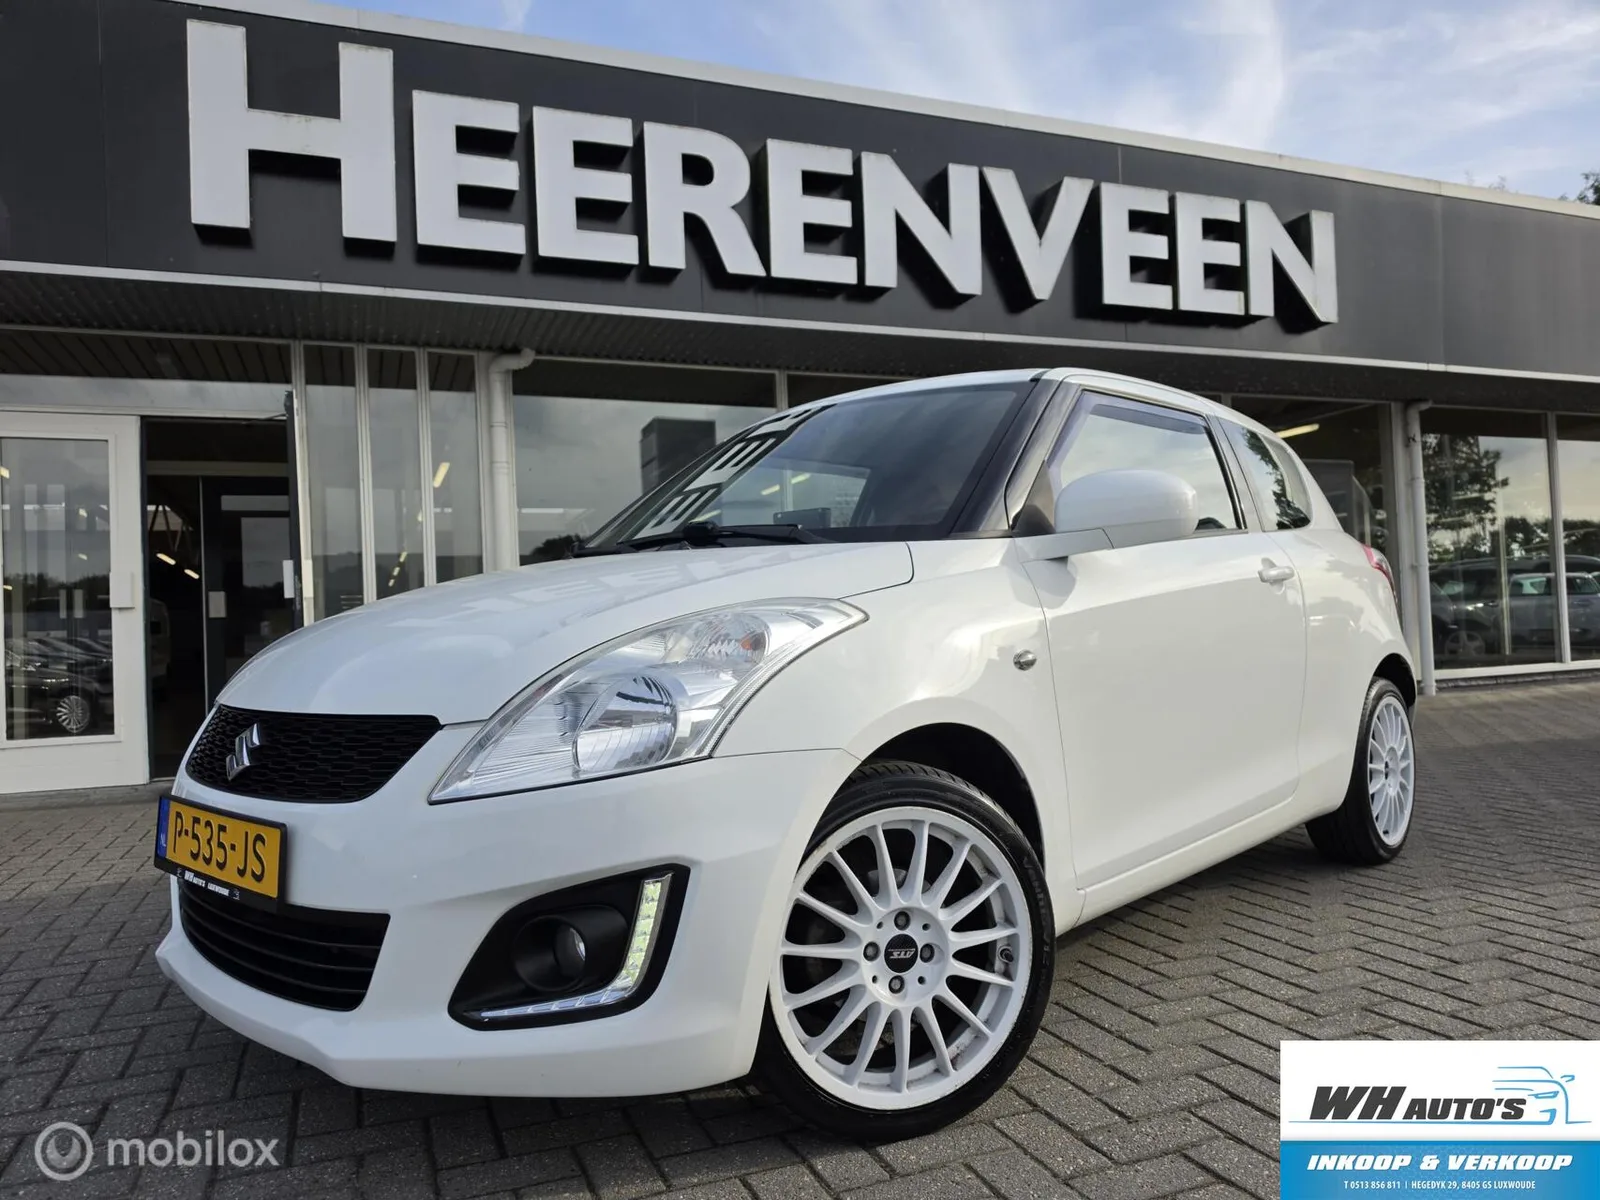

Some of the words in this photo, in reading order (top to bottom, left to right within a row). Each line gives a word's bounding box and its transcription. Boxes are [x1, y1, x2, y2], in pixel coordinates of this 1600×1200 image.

[187, 19, 1338, 324] HEERENVEEN
[173, 810, 267, 883] P-535-JS
[890, 950, 915, 959] ATS
